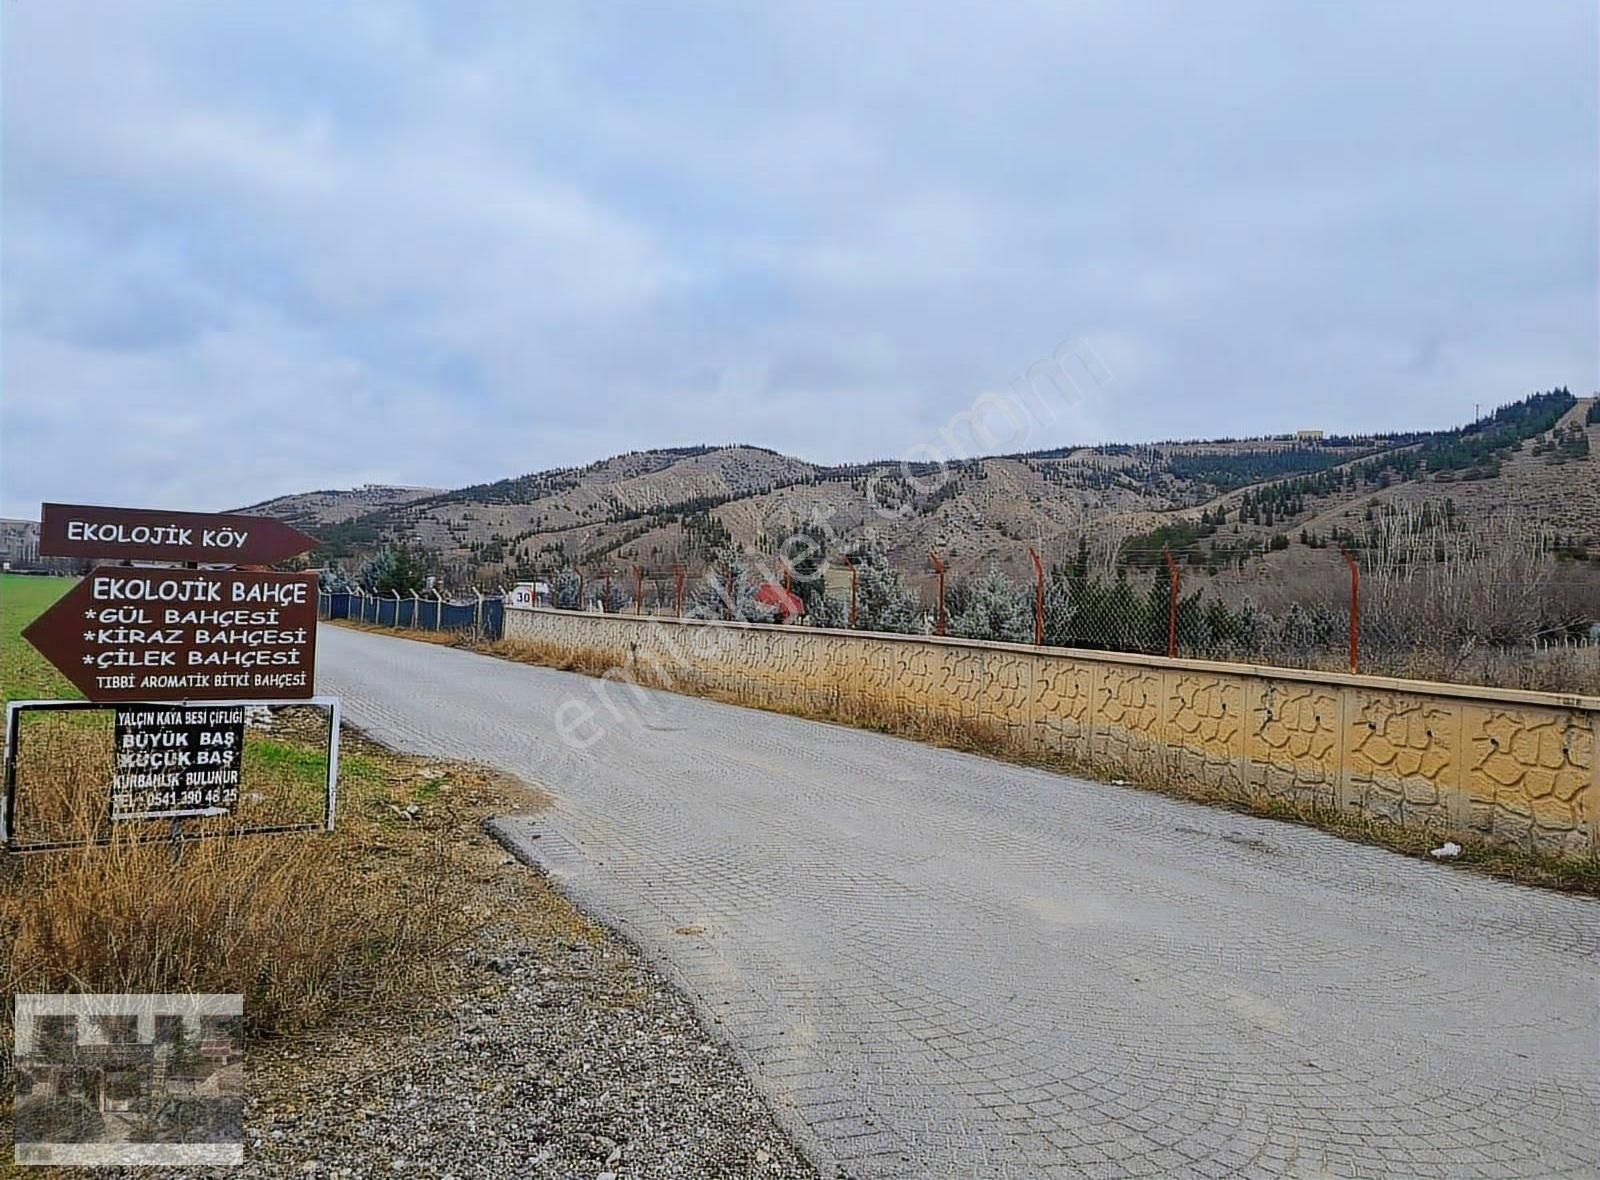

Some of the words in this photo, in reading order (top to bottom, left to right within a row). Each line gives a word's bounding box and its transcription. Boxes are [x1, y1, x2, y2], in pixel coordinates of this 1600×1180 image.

[67, 521, 192, 546] EKOLOJİK
[202, 527, 248, 548] KÖY
[93, 576, 221, 602] EKOLOJİK
[231, 583, 308, 608] BAHÇE
[516, 592, 530, 603] 30
[164, 608, 280, 628] BAHÇESİ
[195, 627, 307, 647] BAHÇESİ
[188, 648, 301, 669] BAHÇESİ
[96, 672, 136, 689] TIBBİ
[140, 672, 211, 689] AROMATİK
[214, 671, 250, 688] BİTKİ
[254, 670, 307, 689] BAHÇESİ
[118, 711, 155, 729] YALÇIN
[156, 711, 182, 726] KAYA
[122, 730, 189, 749] BÜYÜK
[199, 731, 235, 748] BAŞ
[197, 750, 234, 768] BAŞ
[186, 770, 238, 786] BULUNUR
